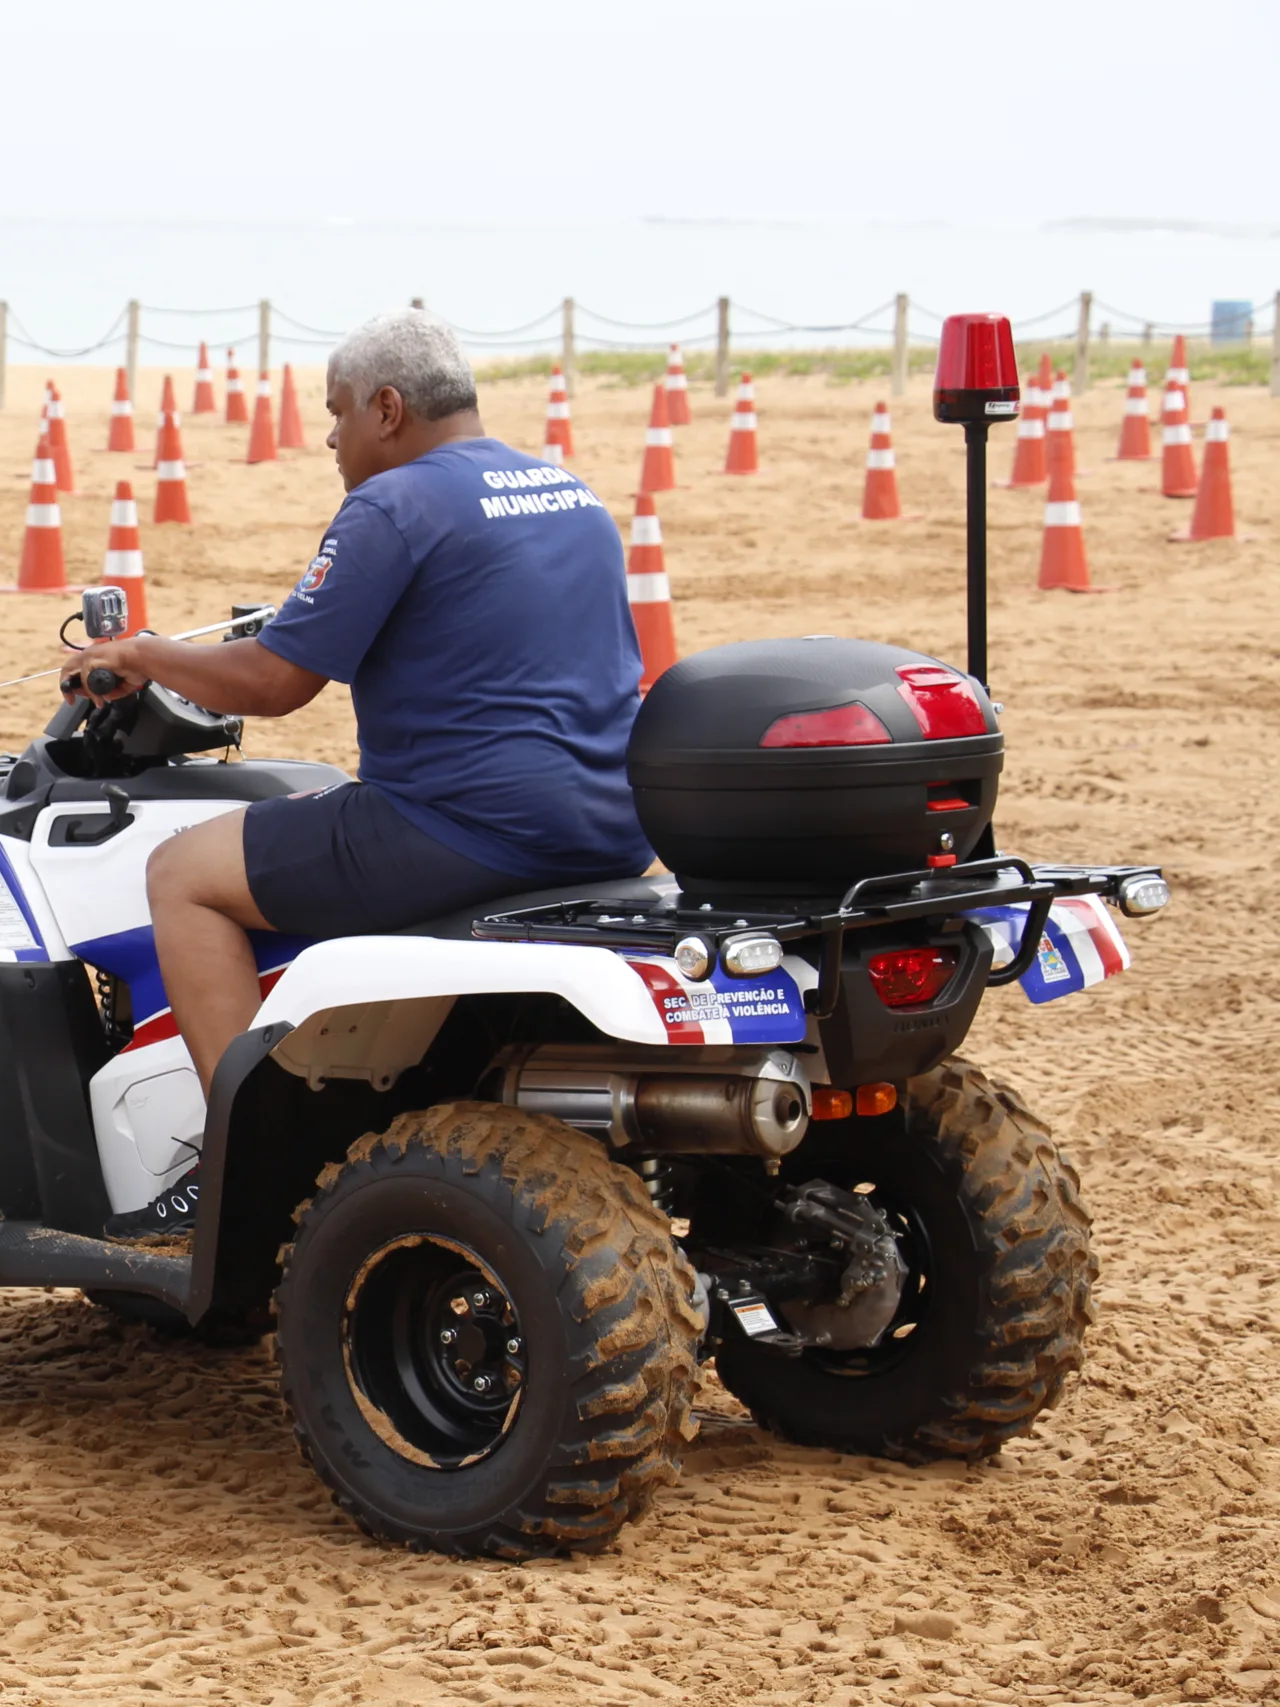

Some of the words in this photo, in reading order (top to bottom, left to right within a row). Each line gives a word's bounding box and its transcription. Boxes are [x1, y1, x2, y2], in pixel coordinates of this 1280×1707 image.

[482, 466, 576, 489] GUARDA
[479, 488, 604, 518] MUNICIPAL
[691, 994, 708, 1006] DE
[777, 989, 785, 1000] E
[665, 1007, 720, 1023] COMBATE
[722, 1004, 730, 1018] À
[732, 1002, 790, 1017] VIOLÊNCIA
